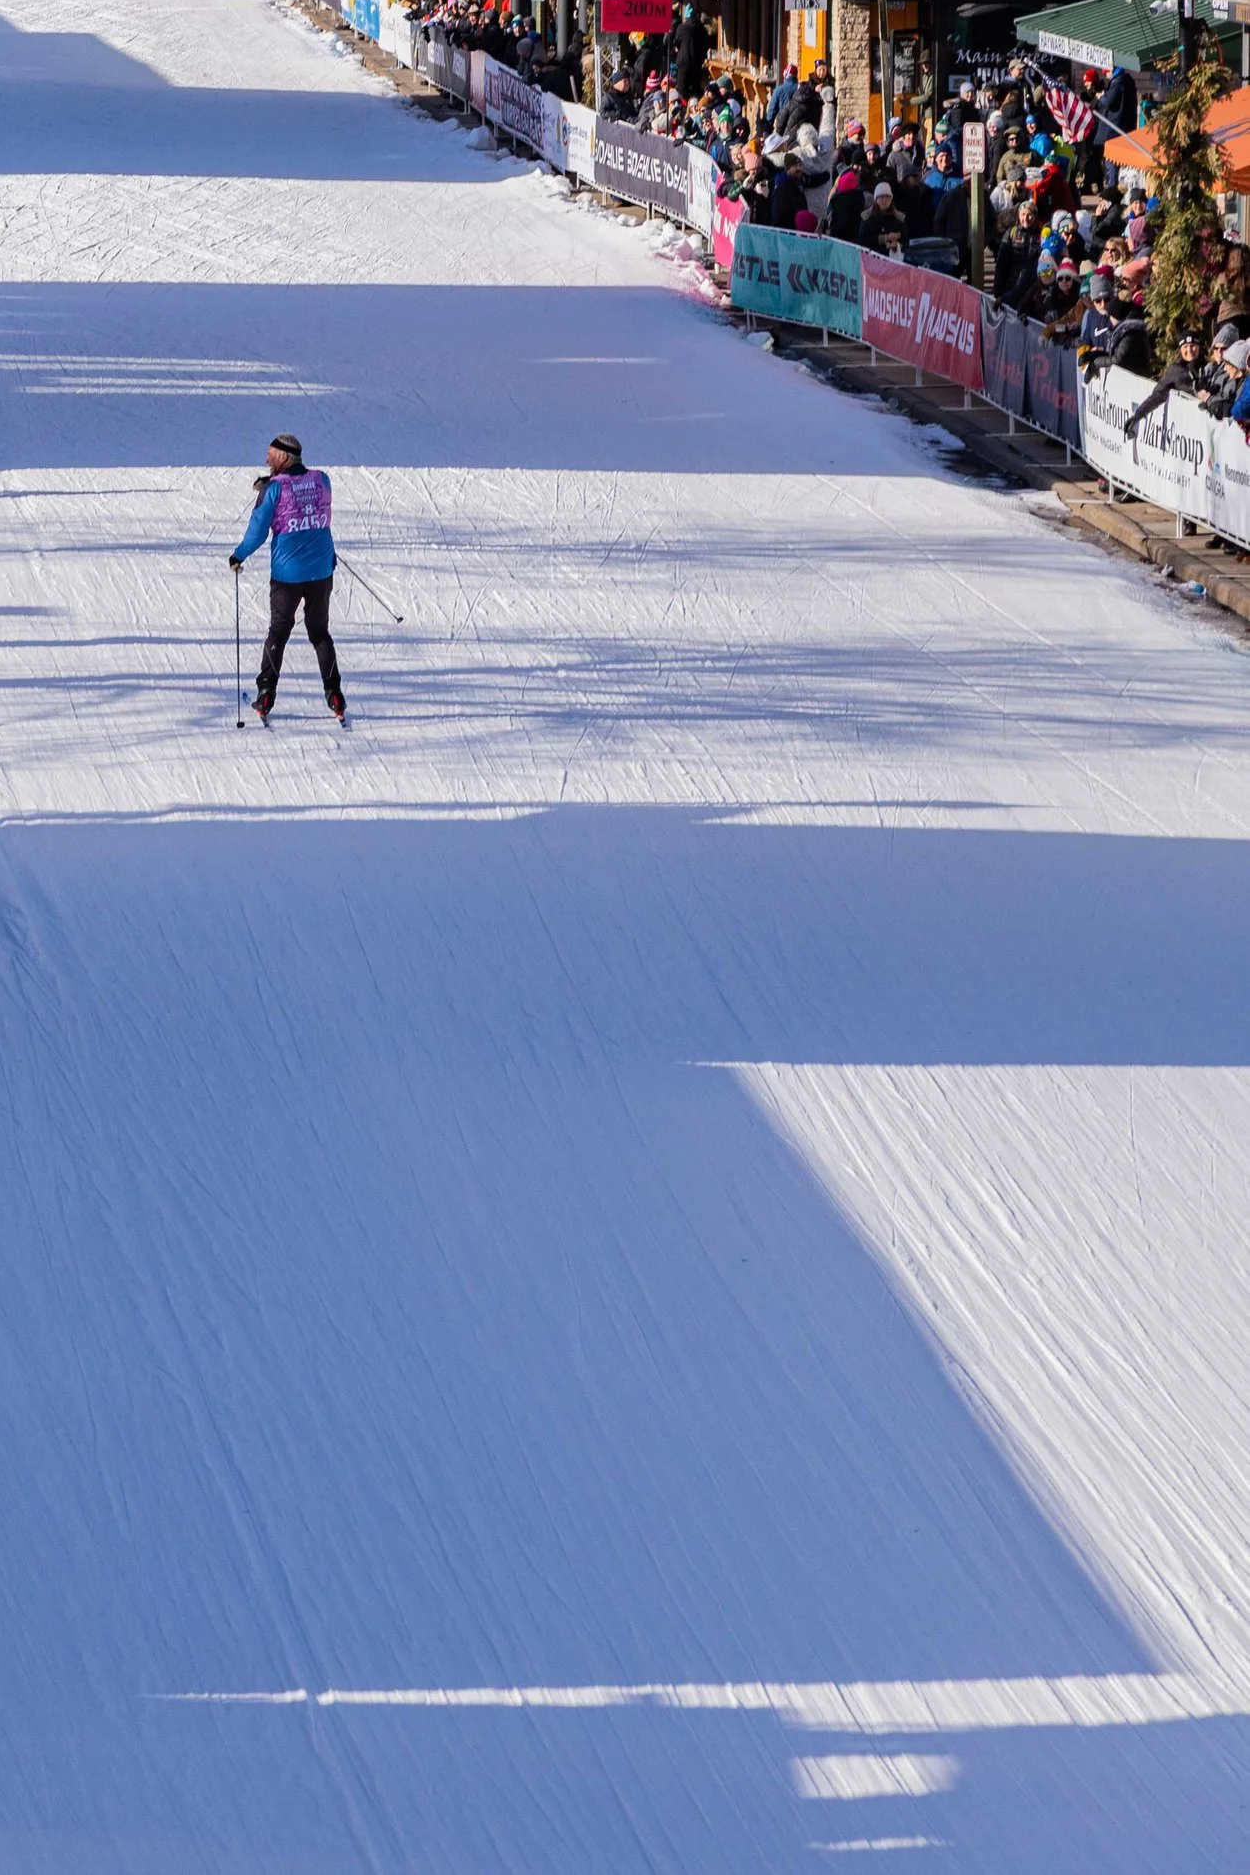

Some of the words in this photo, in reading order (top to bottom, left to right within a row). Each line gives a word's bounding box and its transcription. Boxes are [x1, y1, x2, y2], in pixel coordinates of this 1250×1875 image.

[623, 0, 667, 18] 200M
[955, 47, 1001, 64] Main
[869, 292, 915, 328] MADSHUS
[1140, 411, 1204, 476] MarksGroup
